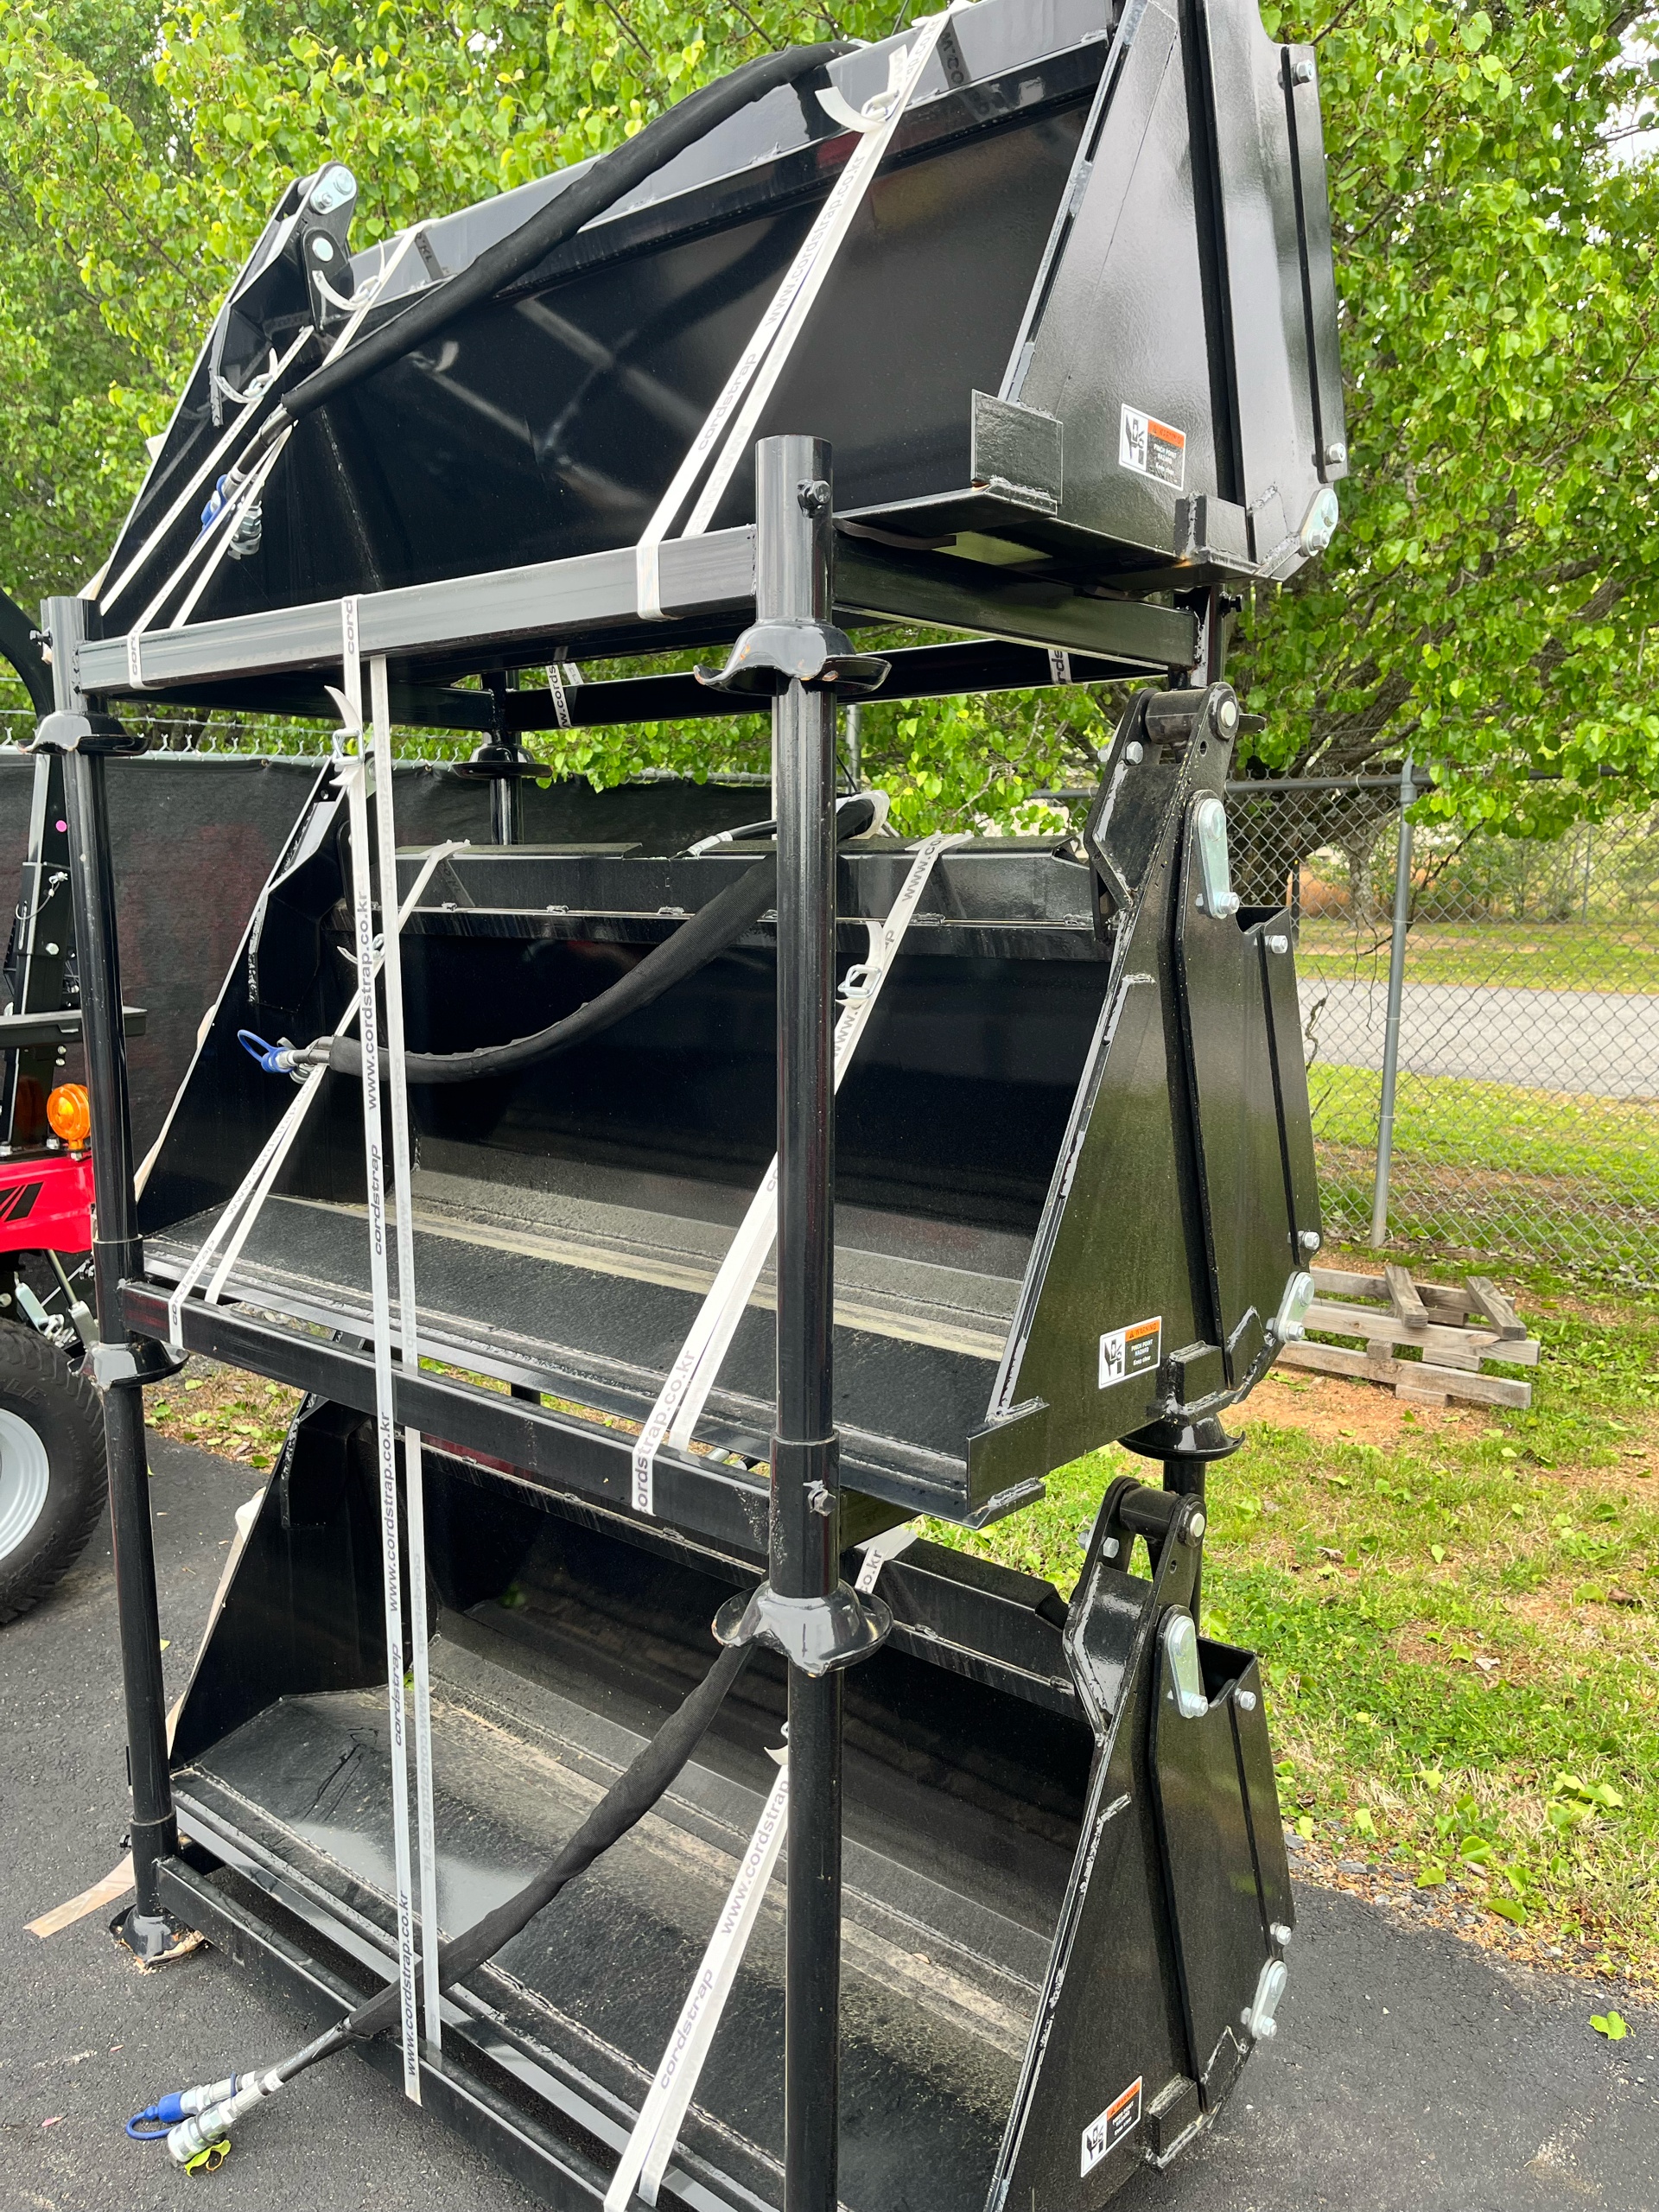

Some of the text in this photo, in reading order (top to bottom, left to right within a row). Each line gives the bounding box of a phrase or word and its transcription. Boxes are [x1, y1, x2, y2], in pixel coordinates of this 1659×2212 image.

[698, 352, 757, 452] cordstrap
[357, 892, 377, 1110] www.cordstrap.co.kr
[370, 1144, 382, 1256] cordstrap
[172, 1238, 216, 1326] cordstrap
[634, 1349, 696, 1513] ordstrap.co.kr
[380, 1410, 399, 1613] www.cordstrap.co.kr
[391, 1642, 403, 1747] cordstrap
[398, 1889, 417, 2077] www.cordstrap.co.kr
[659, 1967, 715, 2091] cordstrap
